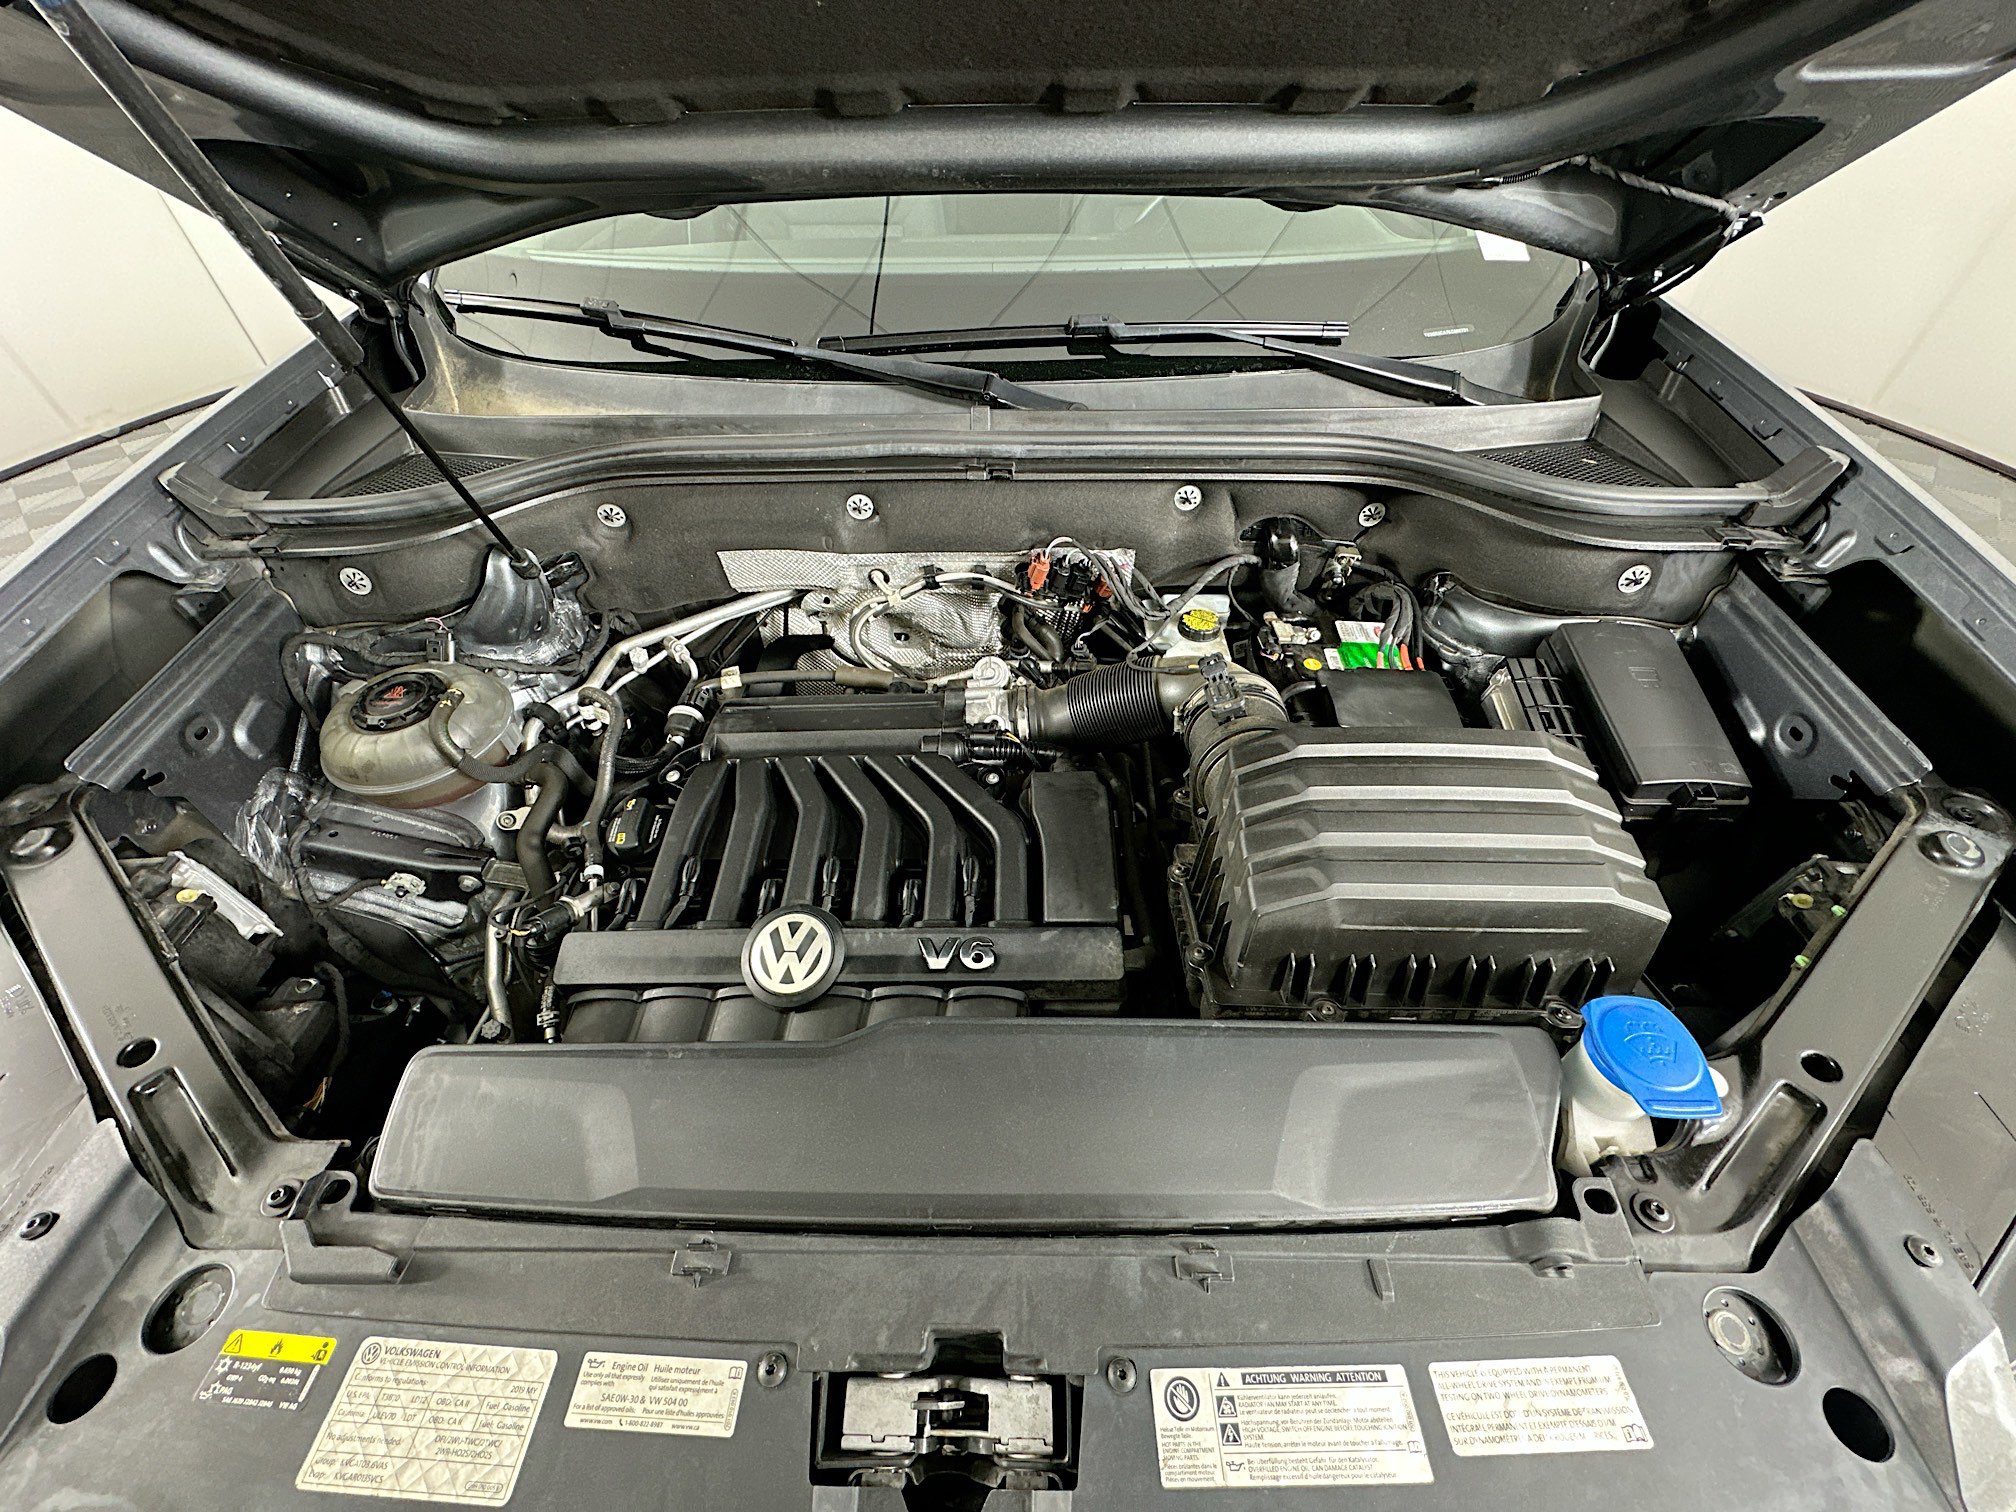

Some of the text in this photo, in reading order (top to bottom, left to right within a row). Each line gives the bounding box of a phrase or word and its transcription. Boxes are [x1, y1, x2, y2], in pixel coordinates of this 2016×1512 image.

[918, 936, 996, 971] V6
[384, 1346, 441, 1359] VOLKSWAGEN
[380, 1357, 510, 1374] VEHICLE EMISSION CONTROL INFORMATION
[612, 1361, 701, 1375] Engine Oil Huile moteur
[1245, 1371, 1382, 1384] ACHTUNG WARNING ATTENTION
[1433, 1371, 1450, 1379] THIS
[1449, 1370, 1478, 1378] VEHICLE
[1488, 1368, 1524, 1378] EQUIPPED
[1524, 1367, 1543, 1375] WITH
[1549, 1365, 1591, 1374] PERMANENT
[622, 1375, 645, 1383] expressly
[670, 1378, 701, 1387] uniquement
[1499, 1379, 1525, 1388] SYSTEM
[1525, 1378, 1541, 1387] AND
[1550, 1377, 1577, 1386] EXEMPT
[1577, 1376, 1597, 1385] FROM
[510, 1386, 538, 1395] 2019 MY
[648, 1385, 657, 1393] qui
[657, 1385, 678, 1393] satisfait
[678, 1386, 714, 1395] expressément
[1440, 1393, 1471, 1402] TESTING
[1471, 1392, 1483, 1401] ON
[1482, 1391, 1501, 1401] TWO
[1502, 1390, 1527, 1400] WHEEL
[1528, 1389, 1549, 1399] DRIVE
[436, 1397, 452, 1406] OBD:
[454, 1399, 464, 1407] CA
[601, 1393, 688, 1407] SAE 0W-30 & VW 504 00
[503, 1403, 530, 1413] Gasoline
[587, 1403, 595, 1411] list
[601, 1406, 625, 1414] approved
[642, 1407, 656, 1415] Pour
[664, 1408, 675, 1416] liste
[372, 1411, 417, 1423] ULEV70 LDT
[428, 1414, 445, 1424] OBD:
[447, 1416, 458, 1425] CA
[1446, 1411, 1456, 1421] CE
[1489, 1410, 1503, 1419] EST
[496, 1421, 525, 1431] Gasoline
[625, 1419, 664, 1428] 1-800-822-8987
[325, 1431, 376, 1445] No adjustments
[1453, 1436, 1470, 1446] SUR
[315, 1457, 336, 1469] Group:
[1248, 1465, 1280, 1473] OVERFILLED
[1311, 1464, 1323, 1472] CAN
